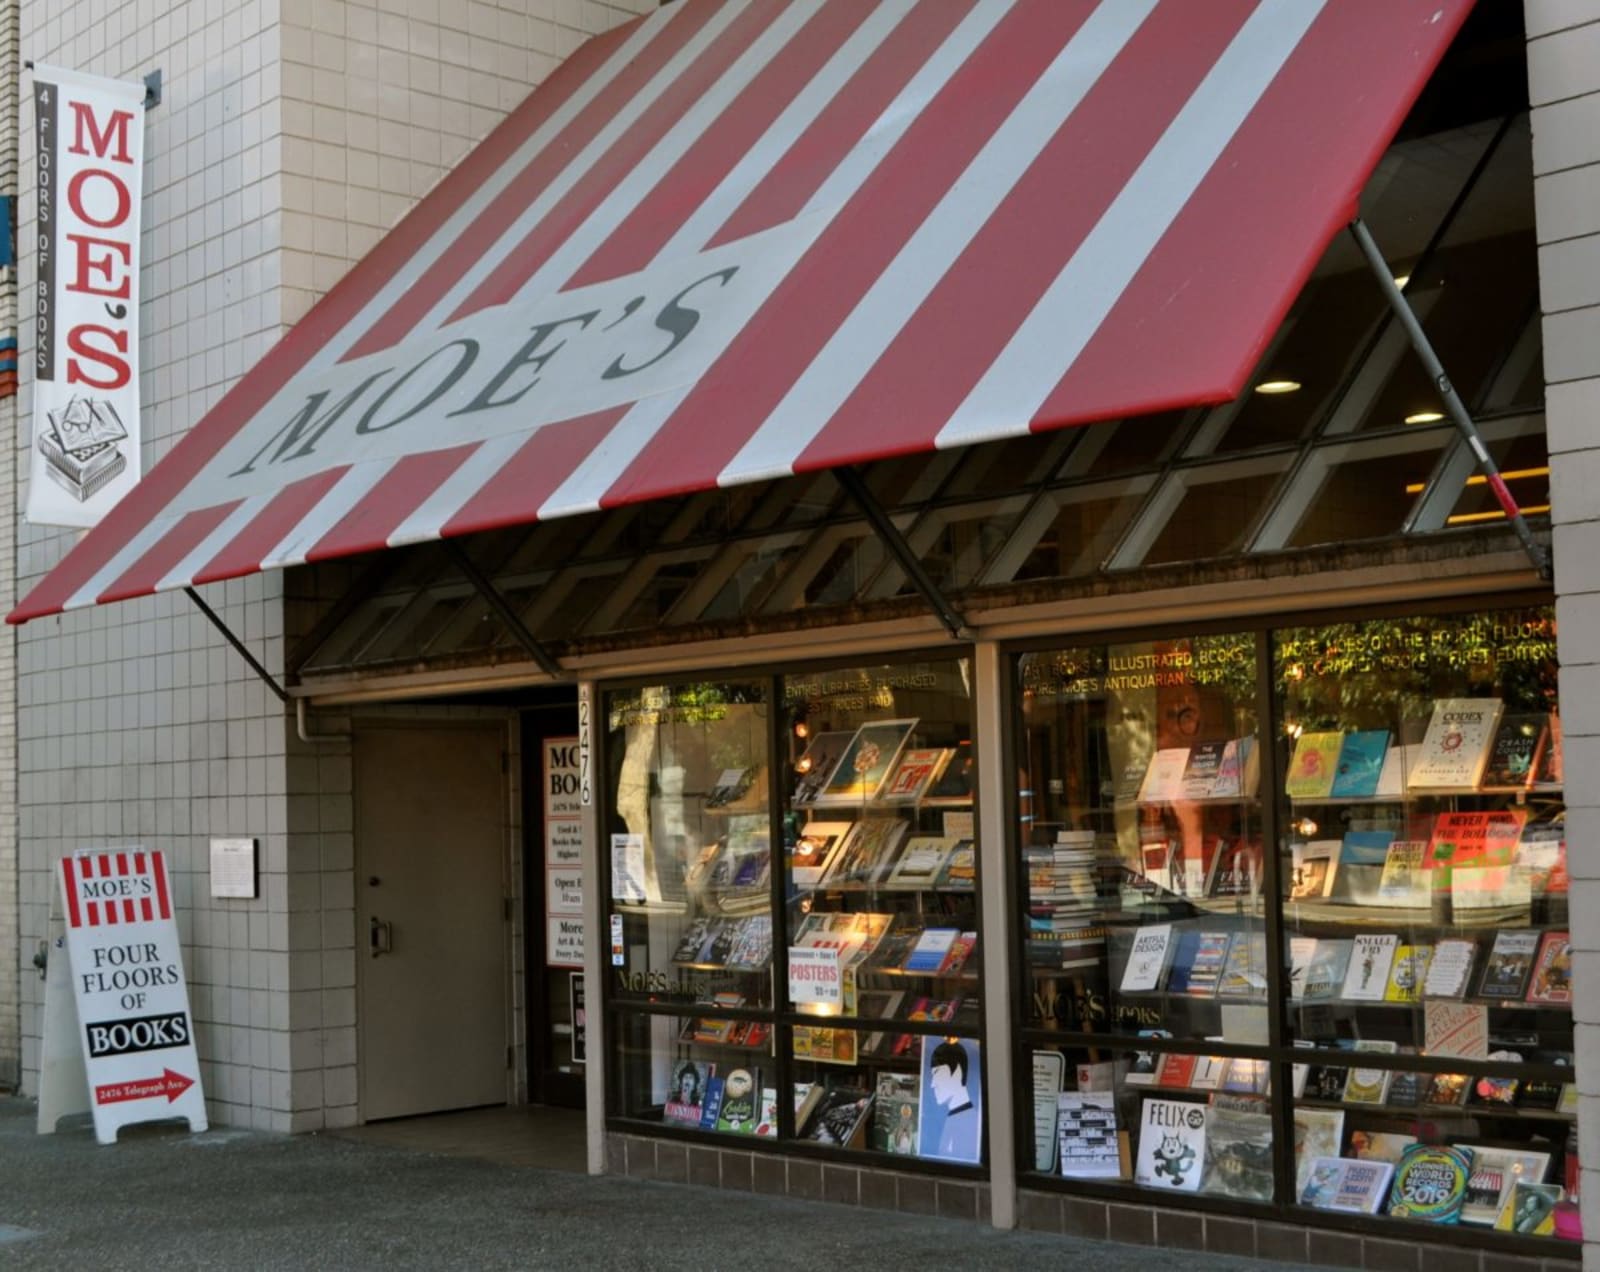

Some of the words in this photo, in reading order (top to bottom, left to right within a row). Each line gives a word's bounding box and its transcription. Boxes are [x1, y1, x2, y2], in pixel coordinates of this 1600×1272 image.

[39, 89, 50, 105] 4
[37, 118, 51, 222] FLOORS
[39, 234, 50, 267] OF
[64, 100, 135, 391] MOE'S
[37, 280, 48, 369] BOOKS
[228, 265, 741, 478] MOE'S
[1493, 622, 1545, 641] FLOOR
[1108, 651, 1194, 671] ILLUSTRATED
[1199, 646, 1245, 665] BOOKS
[1103, 671, 1184, 691] ANTIQUARIAN
[1441, 711, 1485, 722] CODEX
[580, 702, 590, 803] 2476
[83, 876, 153, 899] MOE'S
[93, 942, 160, 969] FOUR
[81, 963, 179, 995] FLOORS
[790, 963, 837, 982] POSTERS
[120, 993, 147, 1011] OF
[89, 1016, 187, 1053] BOOKS
[99, 1088, 122, 1100] 2476
[124, 1080, 166, 1098] Telegraph
[1149, 1103, 1186, 1128] FELIX
[1406, 1177, 1452, 1189] RECORDS
[1409, 1168, 1454, 1181] WORLD
[1402, 1186, 1450, 1204] 2019
